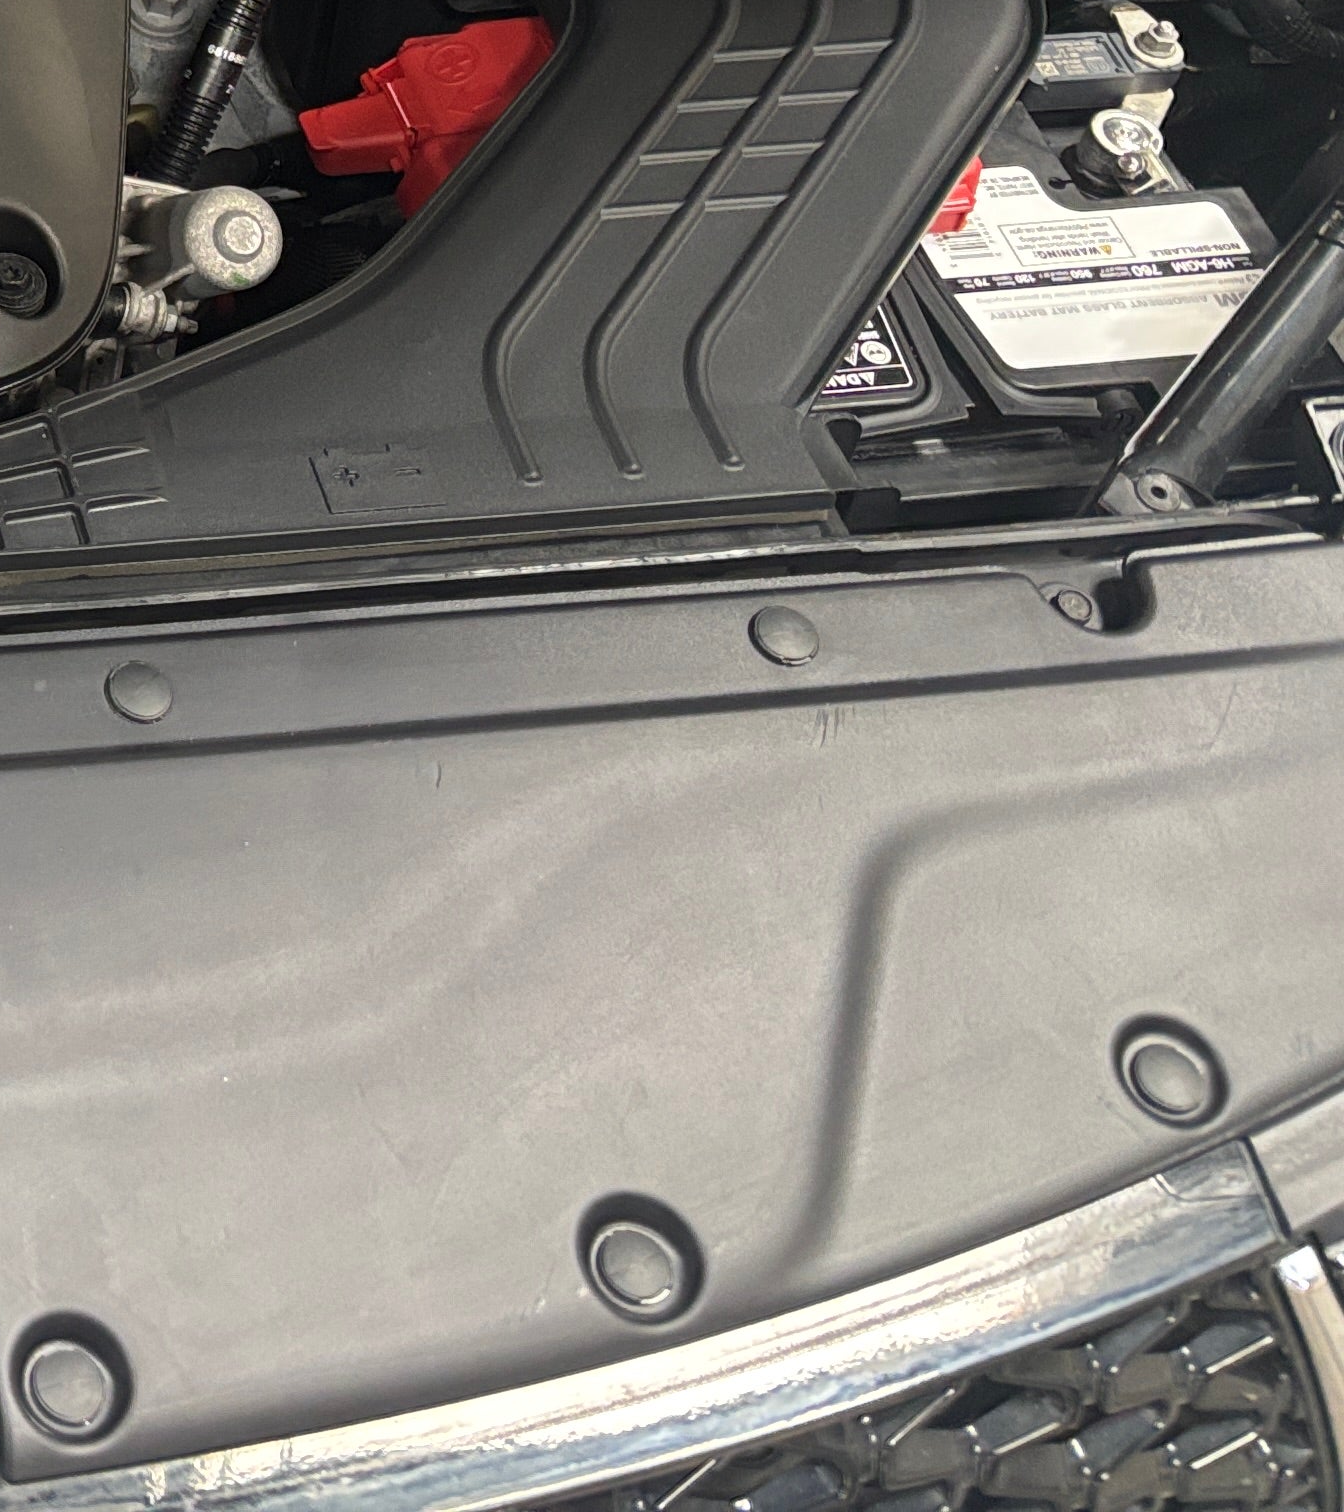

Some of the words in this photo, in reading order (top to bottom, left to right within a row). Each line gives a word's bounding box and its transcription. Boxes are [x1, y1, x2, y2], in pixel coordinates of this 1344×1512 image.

[1033, 245, 1101, 260] WARNING:
[1149, 242, 1241, 257] NON-SPILLABLE
[1130, 263, 1163, 277] 760
[1170, 256, 1235, 274] H6-AGM
